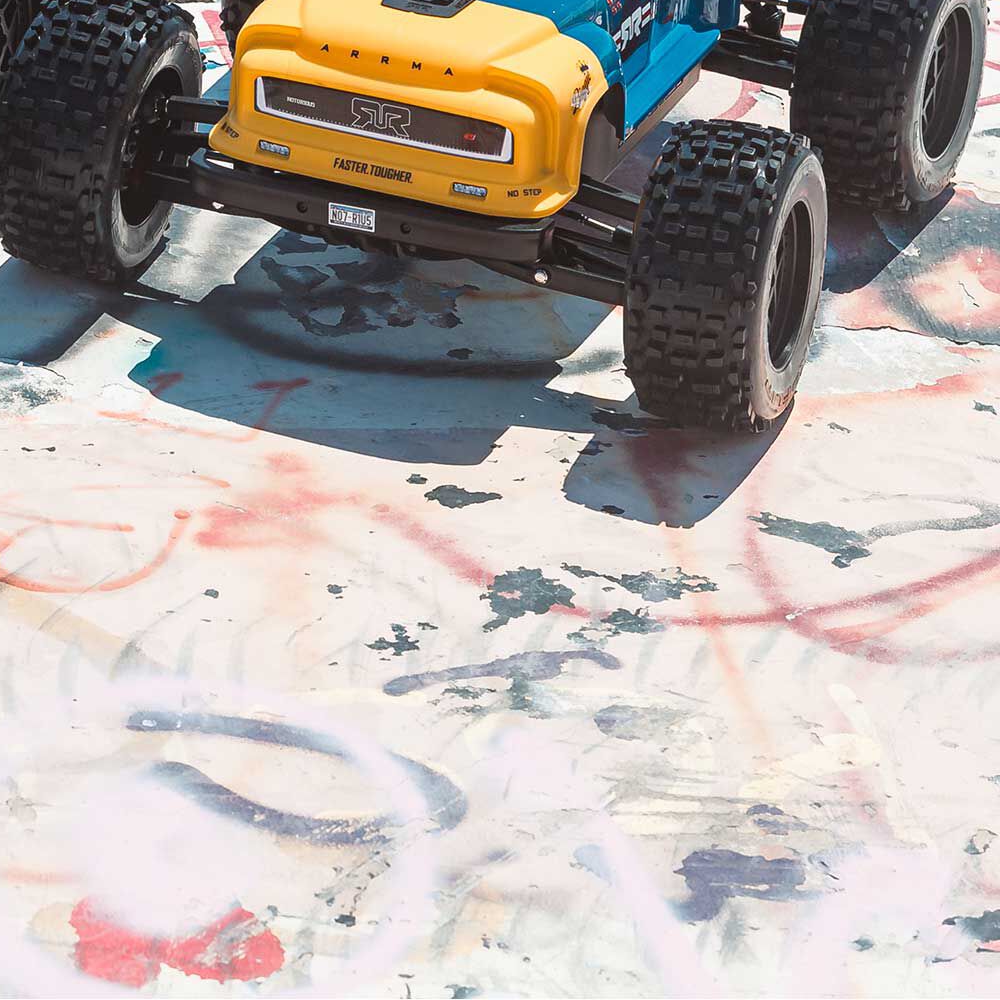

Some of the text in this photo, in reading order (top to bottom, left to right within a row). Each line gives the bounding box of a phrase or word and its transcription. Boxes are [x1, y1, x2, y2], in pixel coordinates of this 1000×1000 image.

[321, 43, 454, 76] ARRMA
[506, 188, 543, 198] NO STEP
